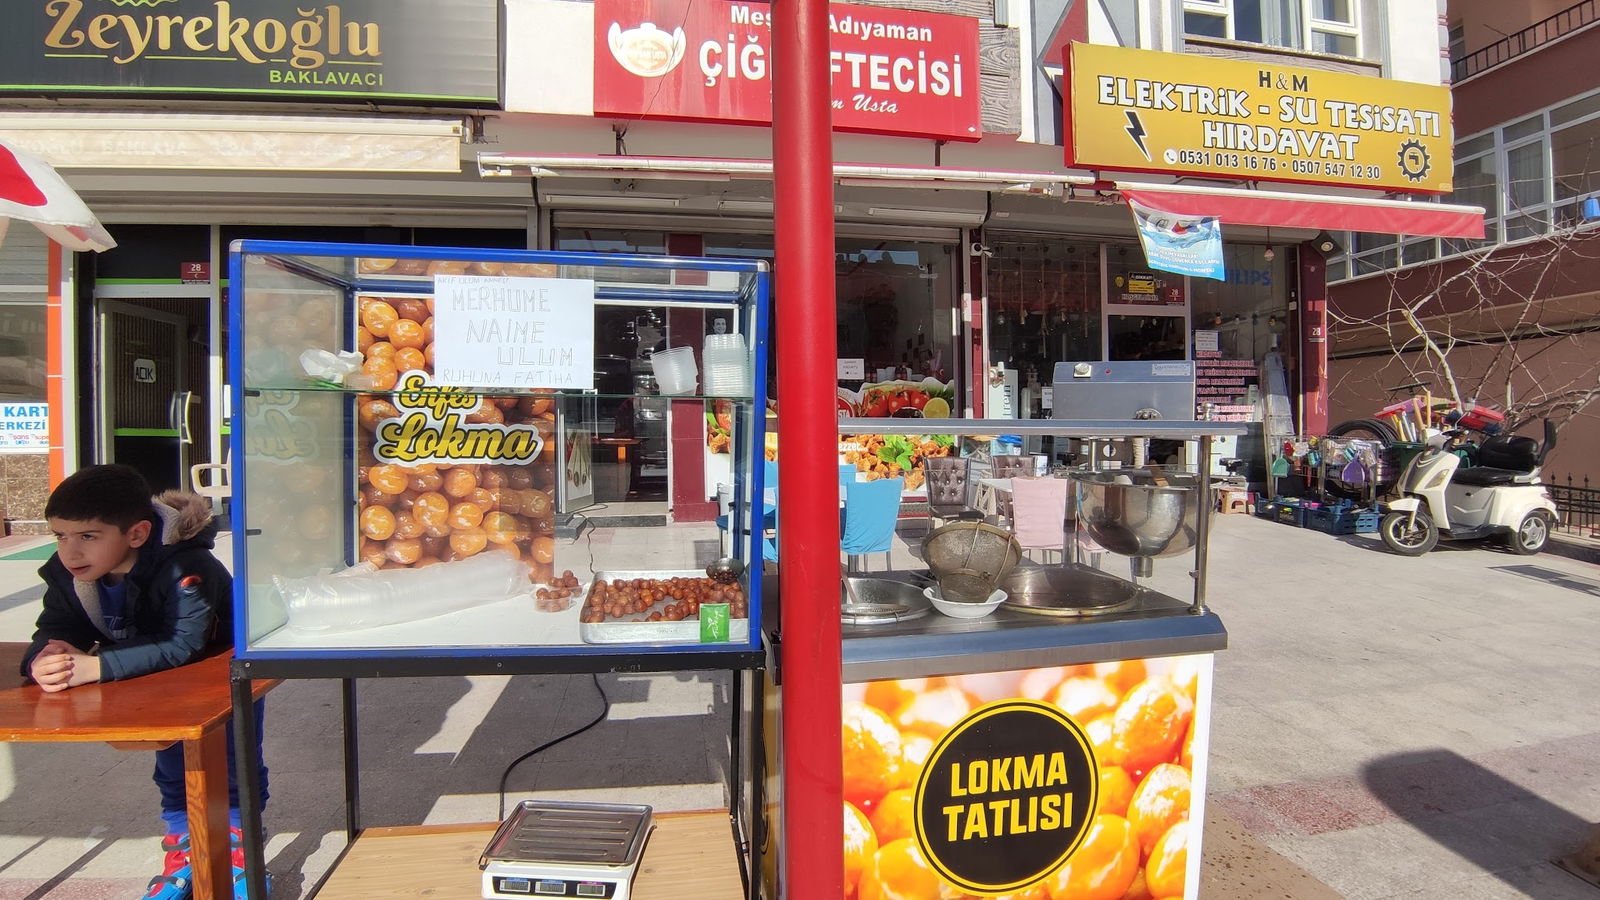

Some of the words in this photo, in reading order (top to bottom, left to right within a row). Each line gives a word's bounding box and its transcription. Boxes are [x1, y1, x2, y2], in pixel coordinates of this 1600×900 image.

[43, 0, 382, 69] Zeyrekoğlu
[829, 13, 933, 43] Adıyaman
[268, 69, 385, 87] BAKLAVACI
[830, 50, 963, 98] FTECİSİ
[851, 93, 899, 115] Usta
[1278, 95, 1319, 125] SU
[1202, 119, 1360, 161] HIRDAVAT
[1179, 150, 1211, 166] 0531
[1215, 152, 1239, 168] 013
[1243, 155, 1258, 170] 16
[1262, 157, 1277, 171] 76
[1292, 160, 1320, 175] 0507
[1325, 162, 1346, 177] 547
[1350, 165, 1363, 178] 12
[1366, 166, 1380, 179] 30
[191, 263, 202, 272] 28
[452, 286, 552, 314] MERHUME
[497, 346, 574, 368] ULUM
[443, 368, 502, 384] RUHUNA
[400, 373, 480, 421] Enfes
[0, 419, 46, 430] ERKEZİ
[379, 411, 538, 462] Lokma
[951, 751, 1069, 798] LOKMA
[942, 792, 1074, 842] TATLISI
